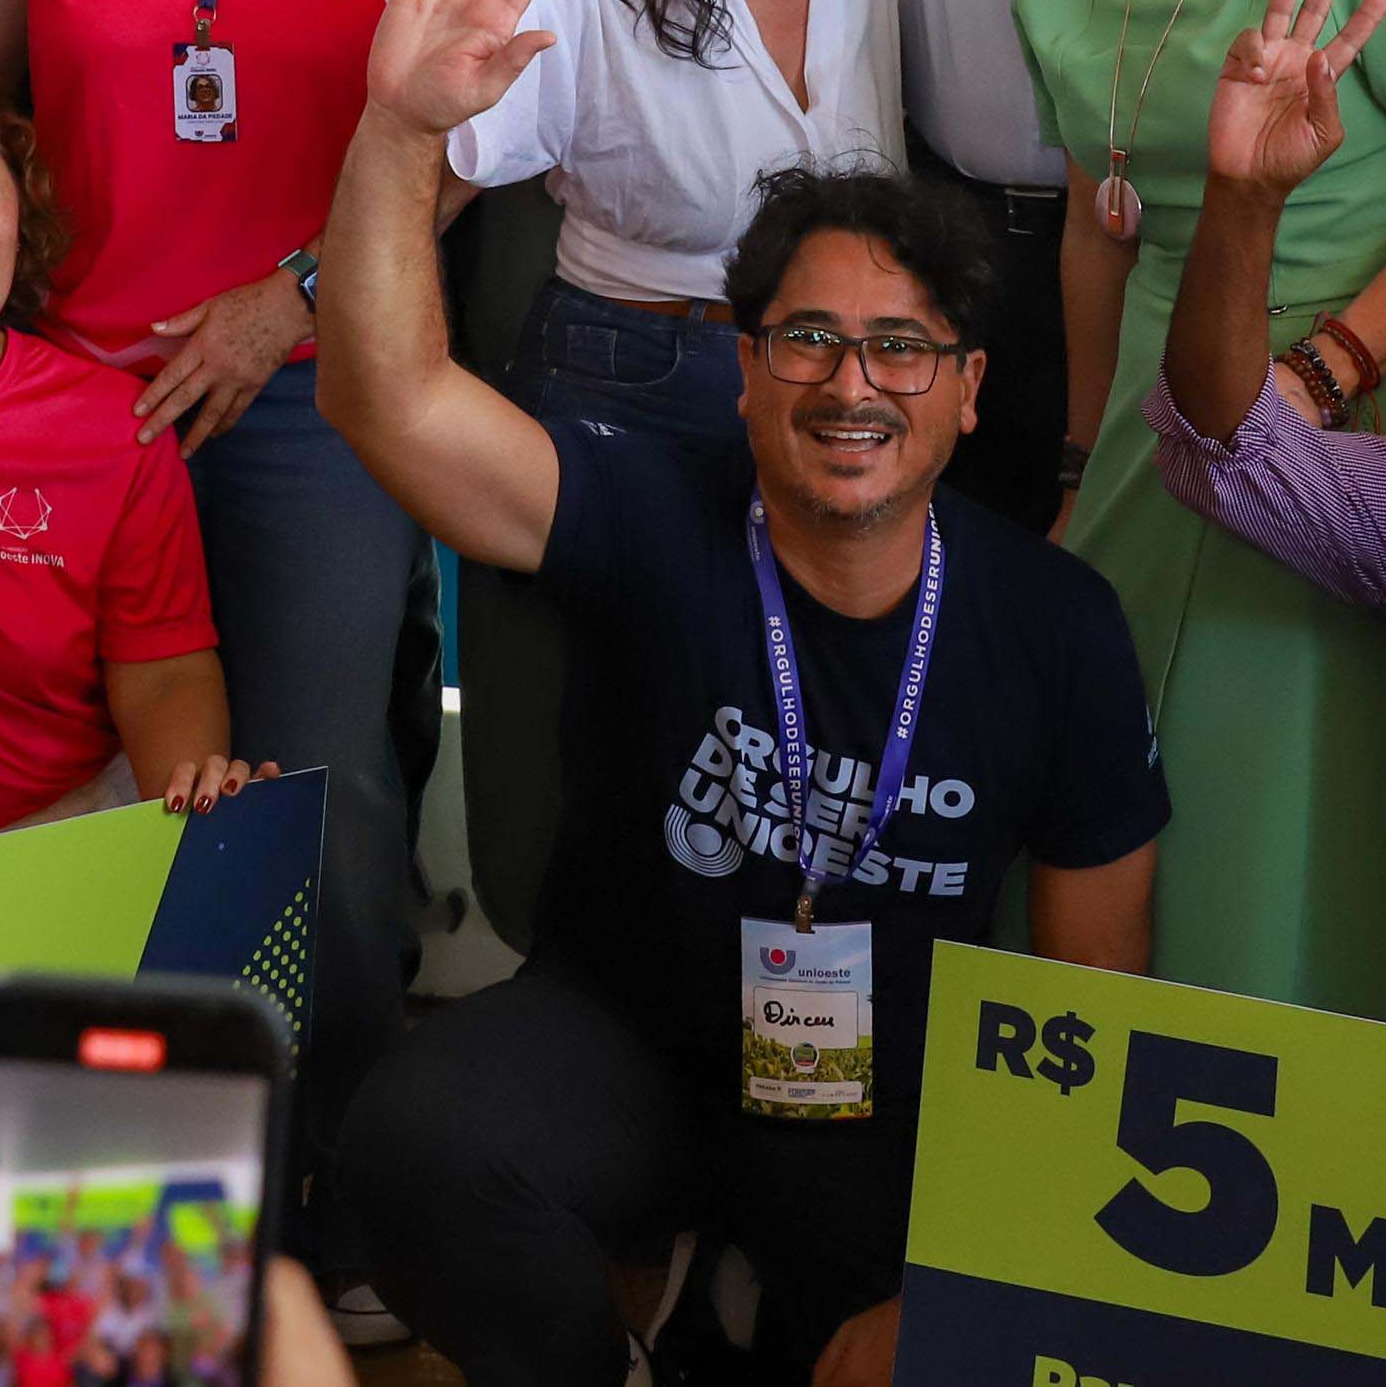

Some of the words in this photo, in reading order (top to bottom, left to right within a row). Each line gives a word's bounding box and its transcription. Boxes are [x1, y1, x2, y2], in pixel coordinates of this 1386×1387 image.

[31, 553, 65, 567] INOVA
[691, 732, 758, 809] DE
[678, 767, 969, 897] UNIOESTE
[798, 968, 851, 978] unioeste
[975, 999, 1097, 1096] R$
[1093, 1029, 1279, 1277] 5
